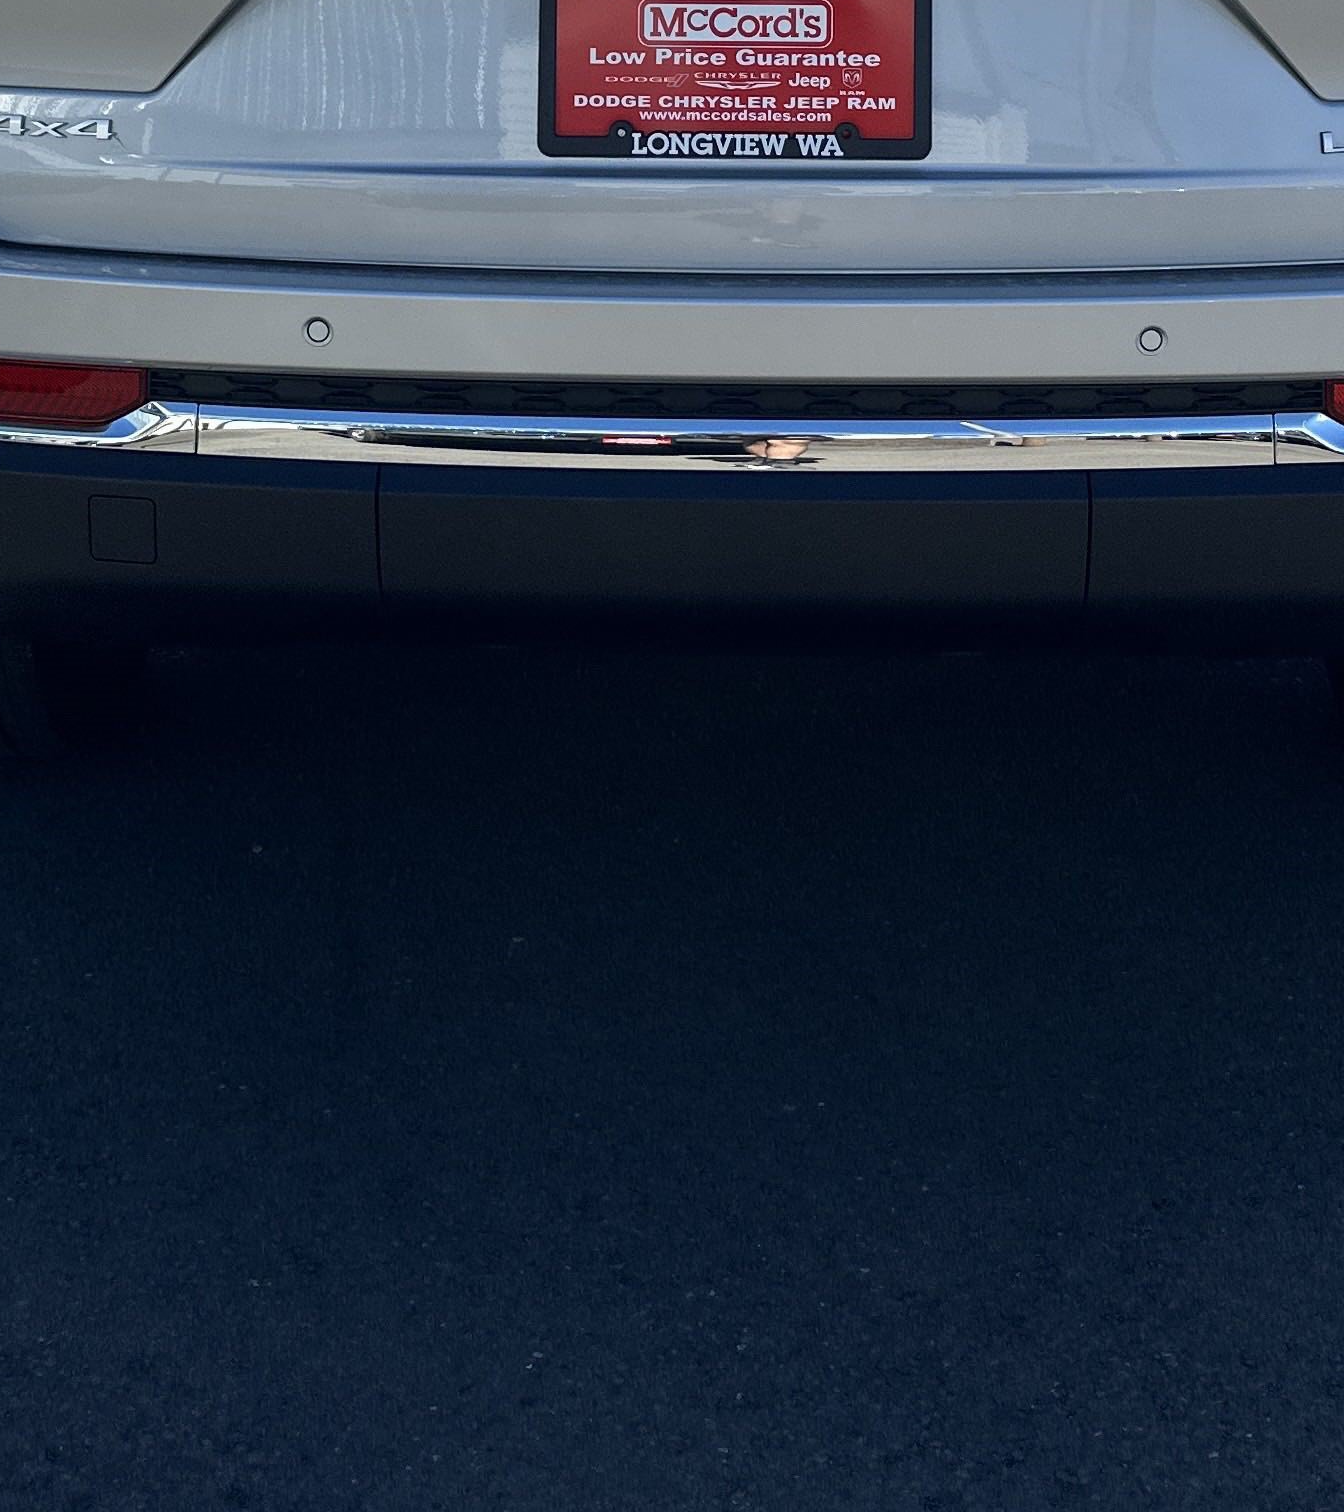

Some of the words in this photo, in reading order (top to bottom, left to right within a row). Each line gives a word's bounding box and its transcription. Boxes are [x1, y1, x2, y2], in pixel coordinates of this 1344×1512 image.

[649, 6, 822, 38] McCord's
[589, 48, 645, 65] Low
[655, 48, 726, 65] Price
[735, 48, 881, 67] Guarantee
[605, 75, 671, 83] DODGE
[693, 71, 781, 80] CHRYSLER
[788, 72, 831, 90] Jeep
[573, 95, 651, 108] DODGE
[658, 96, 777, 109] CHRYSLER
[783, 97, 840, 109] JEEP
[847, 97, 896, 110] RAM
[638, 110, 832, 122] www.mccordsales.com
[631, 132, 786, 155] LONGVIEW
[795, 134, 844, 156] WA
